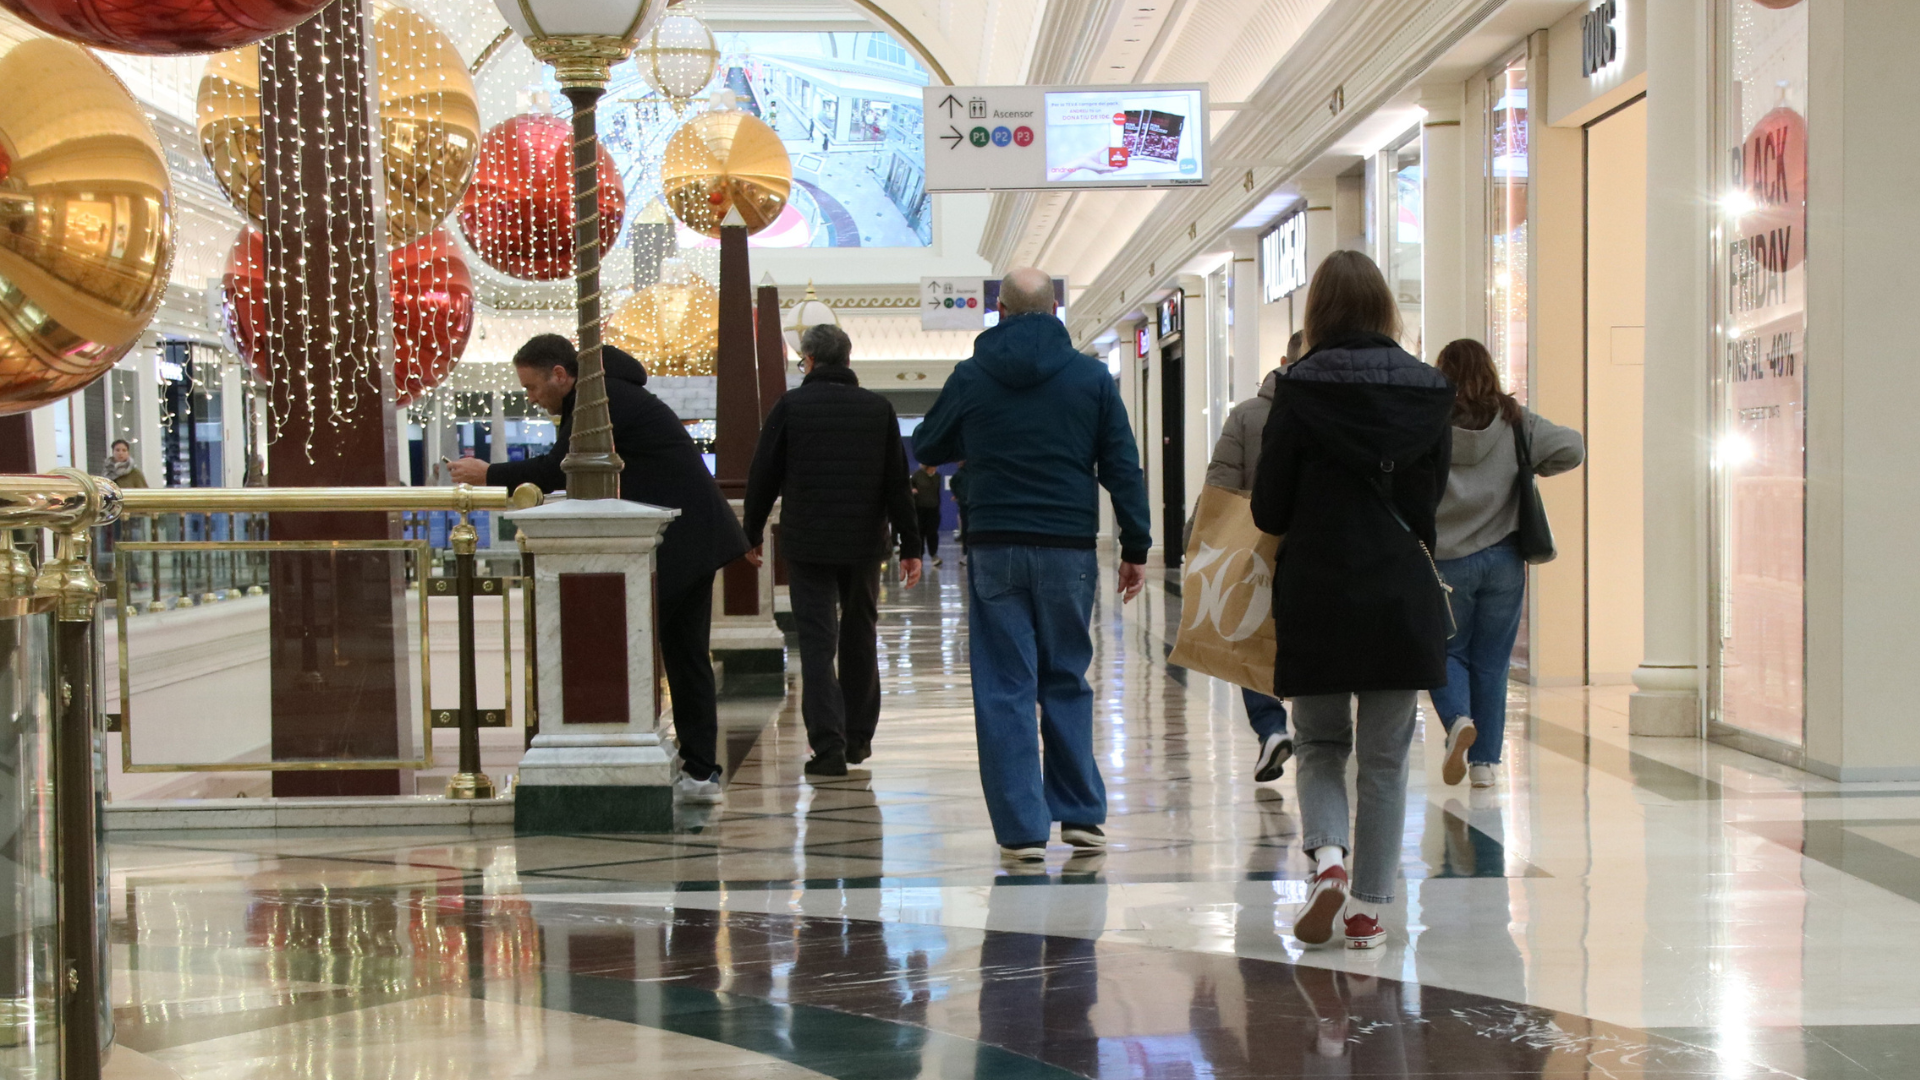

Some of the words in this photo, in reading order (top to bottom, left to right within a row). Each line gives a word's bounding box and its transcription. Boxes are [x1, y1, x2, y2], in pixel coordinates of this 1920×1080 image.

[973, 132, 986, 143] P1
[995, 131, 1009, 142] P2
[1016, 131, 1031, 142] P3
[993, 109, 1034, 119] Ascensor
[1732, 125, 1789, 207] BLACK
[1729, 225, 1791, 315] FRIDAY
[1727, 339, 1748, 384] FINS
[1750, 336, 1764, 381] AL
[1766, 331, 1795, 378] -40%
